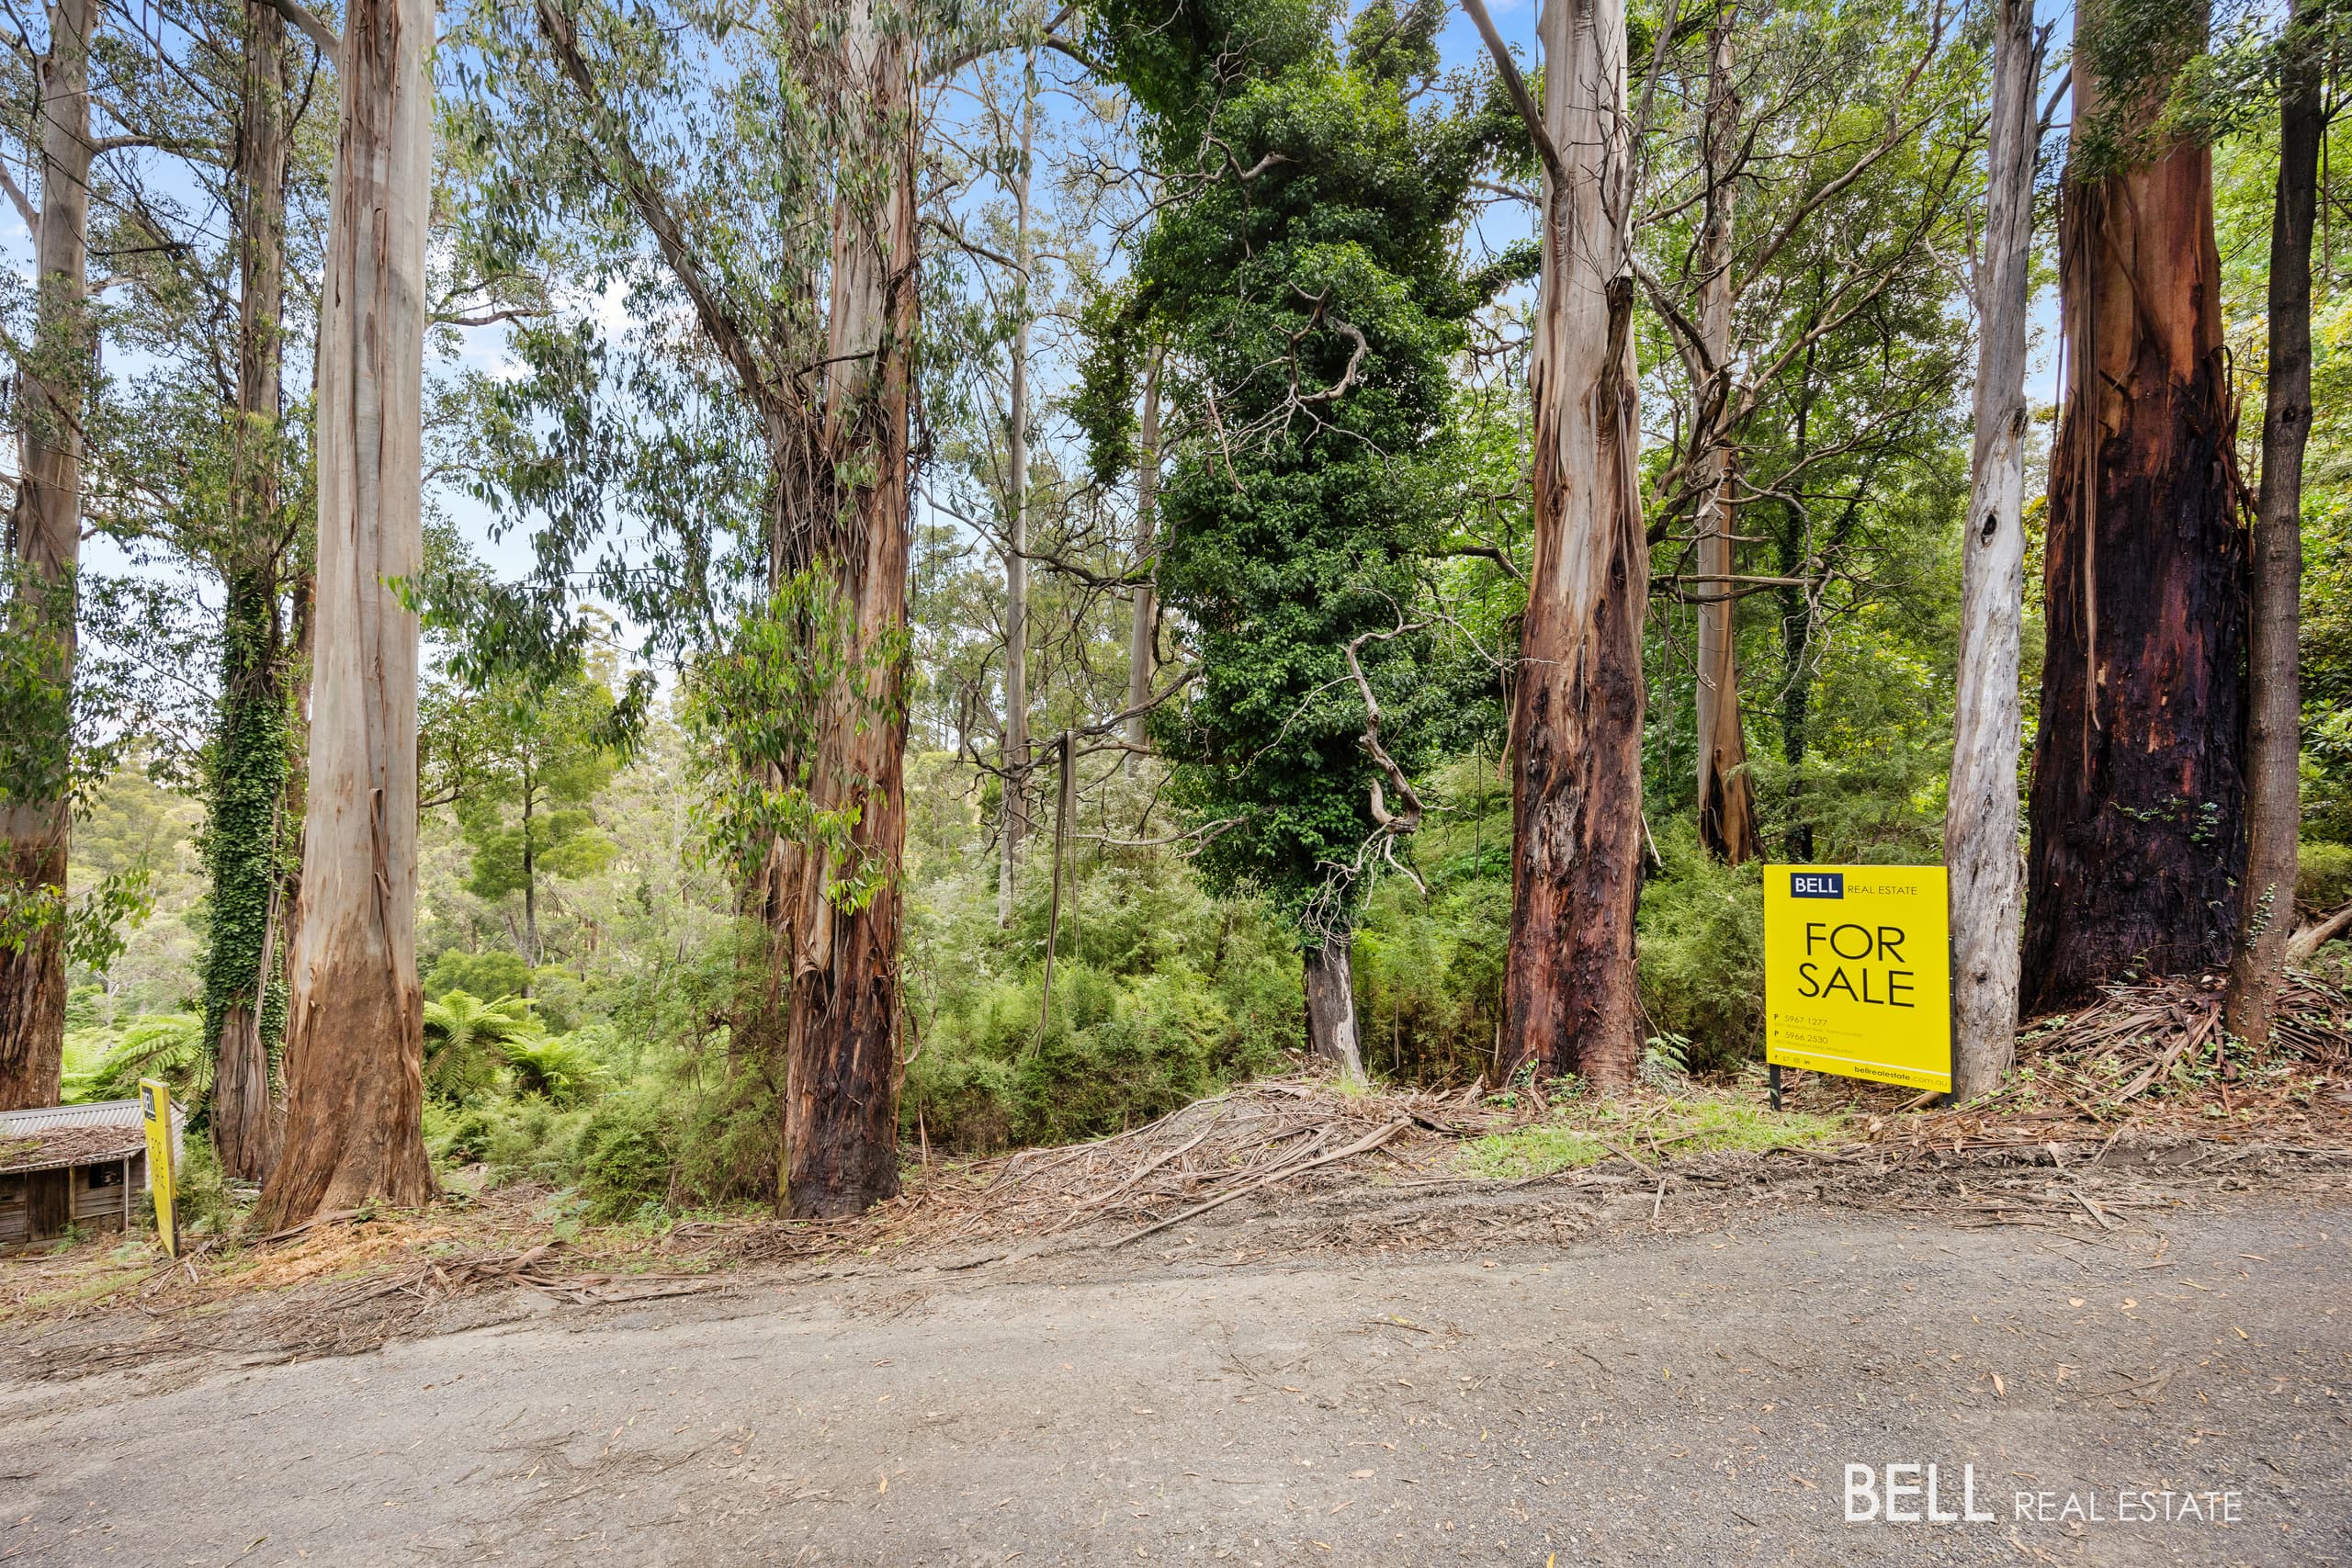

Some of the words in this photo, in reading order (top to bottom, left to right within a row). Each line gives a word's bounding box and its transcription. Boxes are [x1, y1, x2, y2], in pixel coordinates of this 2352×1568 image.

[1795, 877, 1838, 894] BELL
[1847, 886, 1875, 895] REAL
[1878, 886, 1917, 896] ESTATE
[1806, 922, 1906, 964] FOR
[1797, 963, 1915, 1008] SALE
[1784, 1014, 1804, 1023] 5967
[1807, 1017, 1828, 1027] 1277
[1785, 1031, 1805, 1042] 5966
[1807, 1034, 1829, 1044] 2530
[1854, 1066, 1948, 1087] bellrealestate.com.au
